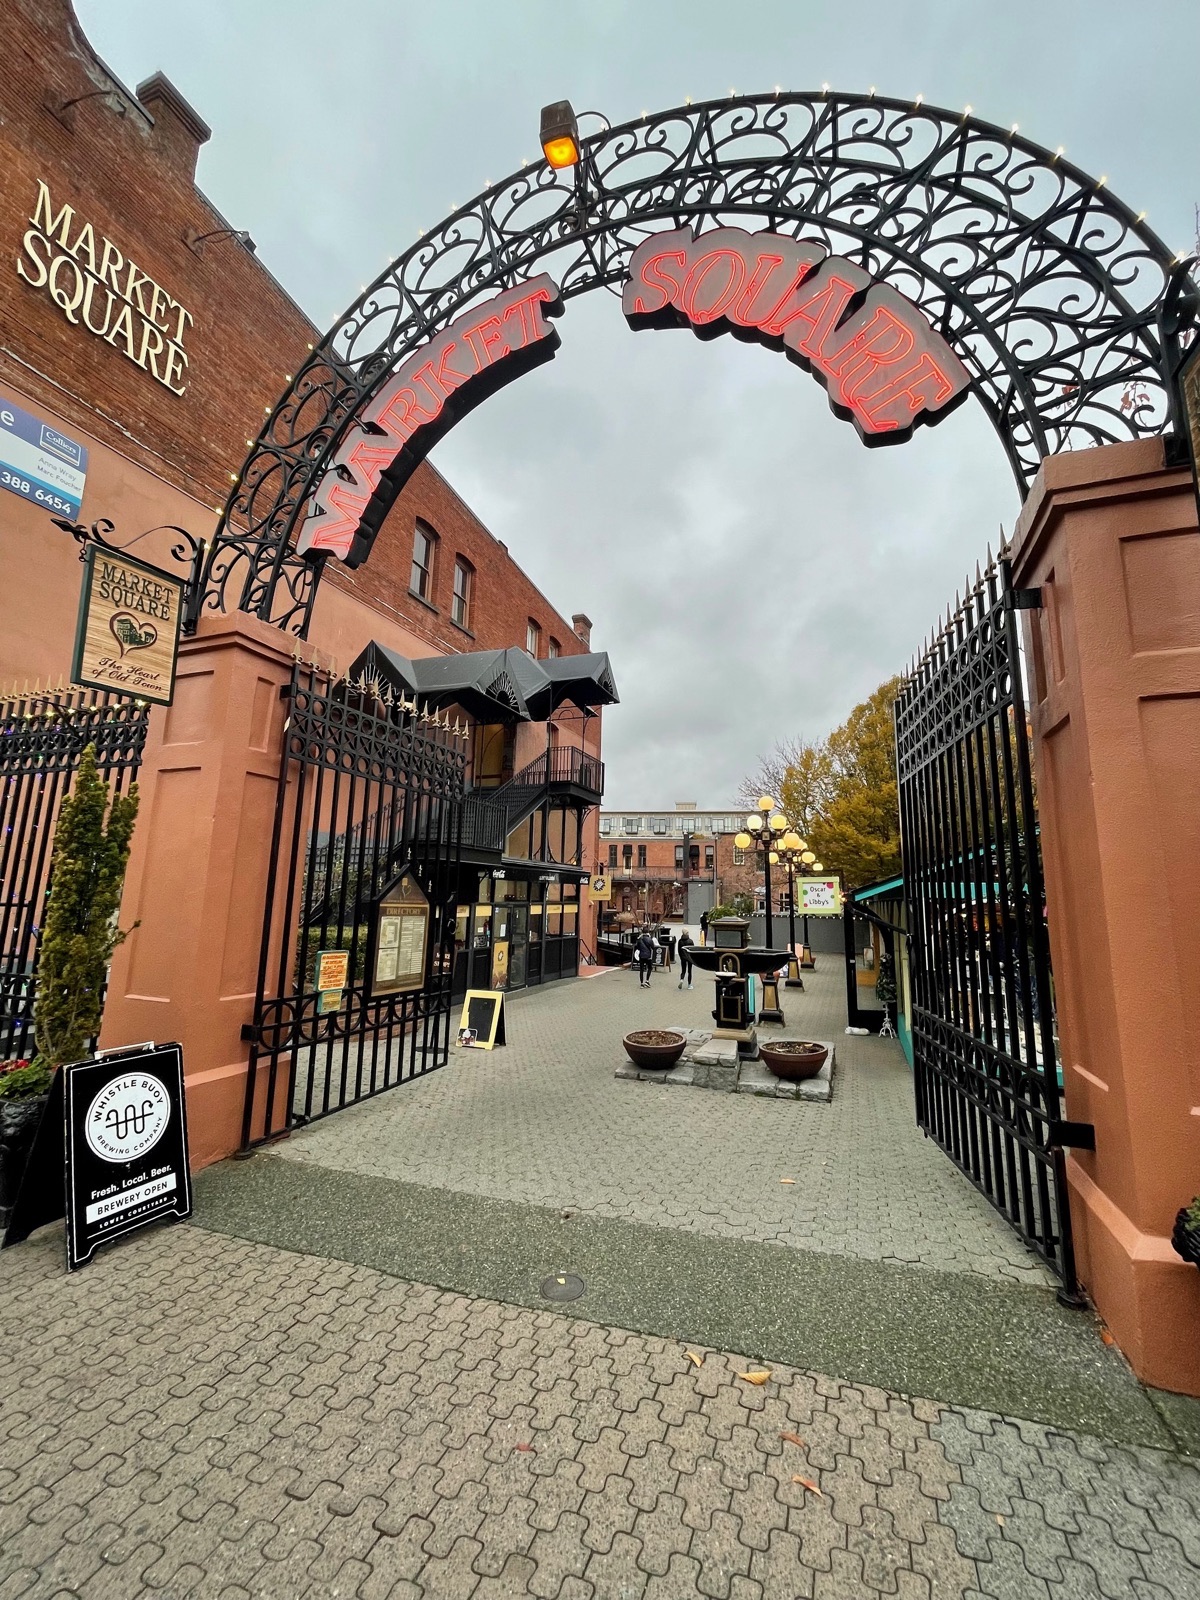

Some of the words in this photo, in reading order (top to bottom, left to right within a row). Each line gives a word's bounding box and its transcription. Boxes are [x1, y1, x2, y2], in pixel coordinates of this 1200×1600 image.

[29, 178, 194, 348] MARKET
[17, 230, 188, 396] SQUARE
[312, 288, 551, 551] MARKET
[634, 249, 954, 432] SQUARE
[46, 431, 77, 454] Colliers
[37, 465, 54, 479] Marc
[38, 457, 58, 471] Anna
[60, 466, 77, 482] Wray
[0, 471, 31, 494] 388
[35, 489, 71, 514] 6454
[101, 562, 174, 605] MARKET
[99, 581, 171, 622] SQUARE
[92, 668, 105, 679] of
[108, 670, 128, 683] Old
[132, 678, 168, 692] Town
[98, 657, 123, 671] The
[127, 665, 160, 681] Heart
[386, 907, 422, 916] DIRECTORY
[809, 898, 829, 906] Libby's
[93, 1079, 138, 1122] WHISTLE
[141, 1080, 164, 1105] BUOY
[96, 1134, 130, 1155] BREWING
[133, 1116, 162, 1151] COMPANY
[91, 1183, 120, 1200] Fresh.
[122, 1172, 149, 1189] Local.
[151, 1164, 172, 1178] Beer.
[97, 1191, 141, 1216] BREWERY
[144, 1181, 168, 1197] OPEN
[99, 1213, 124, 1229] LOWER
[127, 1196, 168, 1217] COURTYARD
